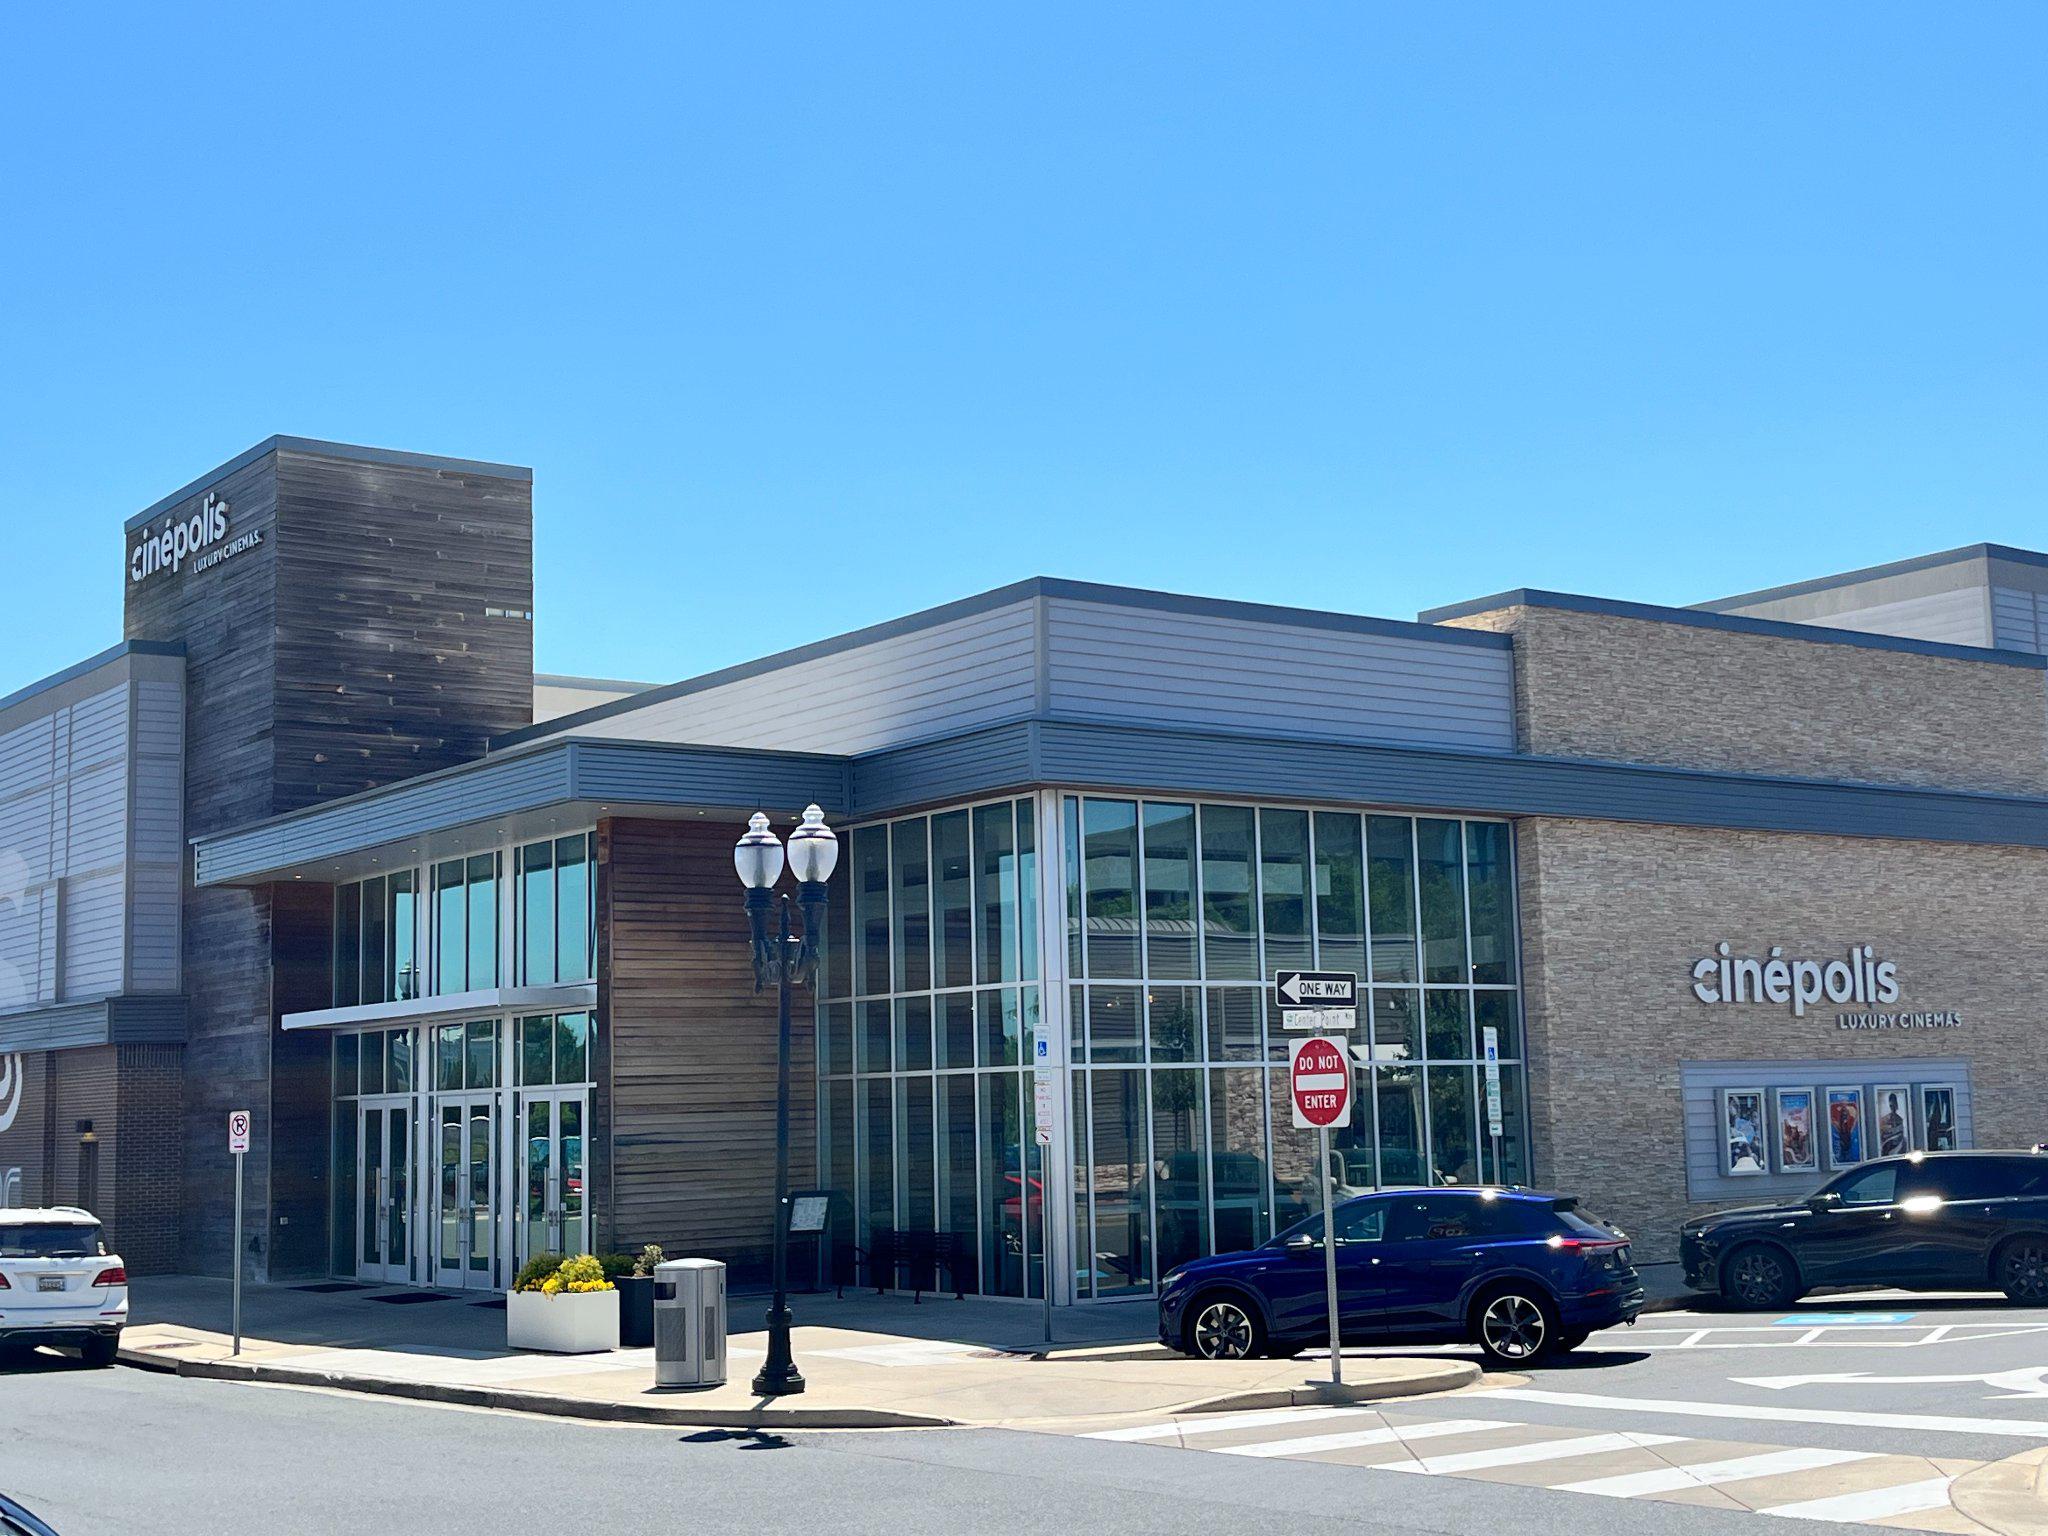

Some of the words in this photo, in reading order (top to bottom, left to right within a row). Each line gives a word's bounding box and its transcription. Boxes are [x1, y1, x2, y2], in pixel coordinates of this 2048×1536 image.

[131, 492, 227, 582] cinépolis
[193, 548, 224, 574] LUXURY
[223, 529, 261, 559] CINEMAS
[1693, 942, 1899, 1016] cinépolis
[1299, 982, 1322, 996] ONE
[1325, 983, 1347, 996] WAY
[1839, 1013, 1896, 1029] LUXURY
[1899, 1012, 1962, 1029] CINEMAS
[1299, 1056, 1314, 1071] DO
[1318, 1055, 1339, 1070] NOT
[1304, 1094, 1337, 1109] ENTER
